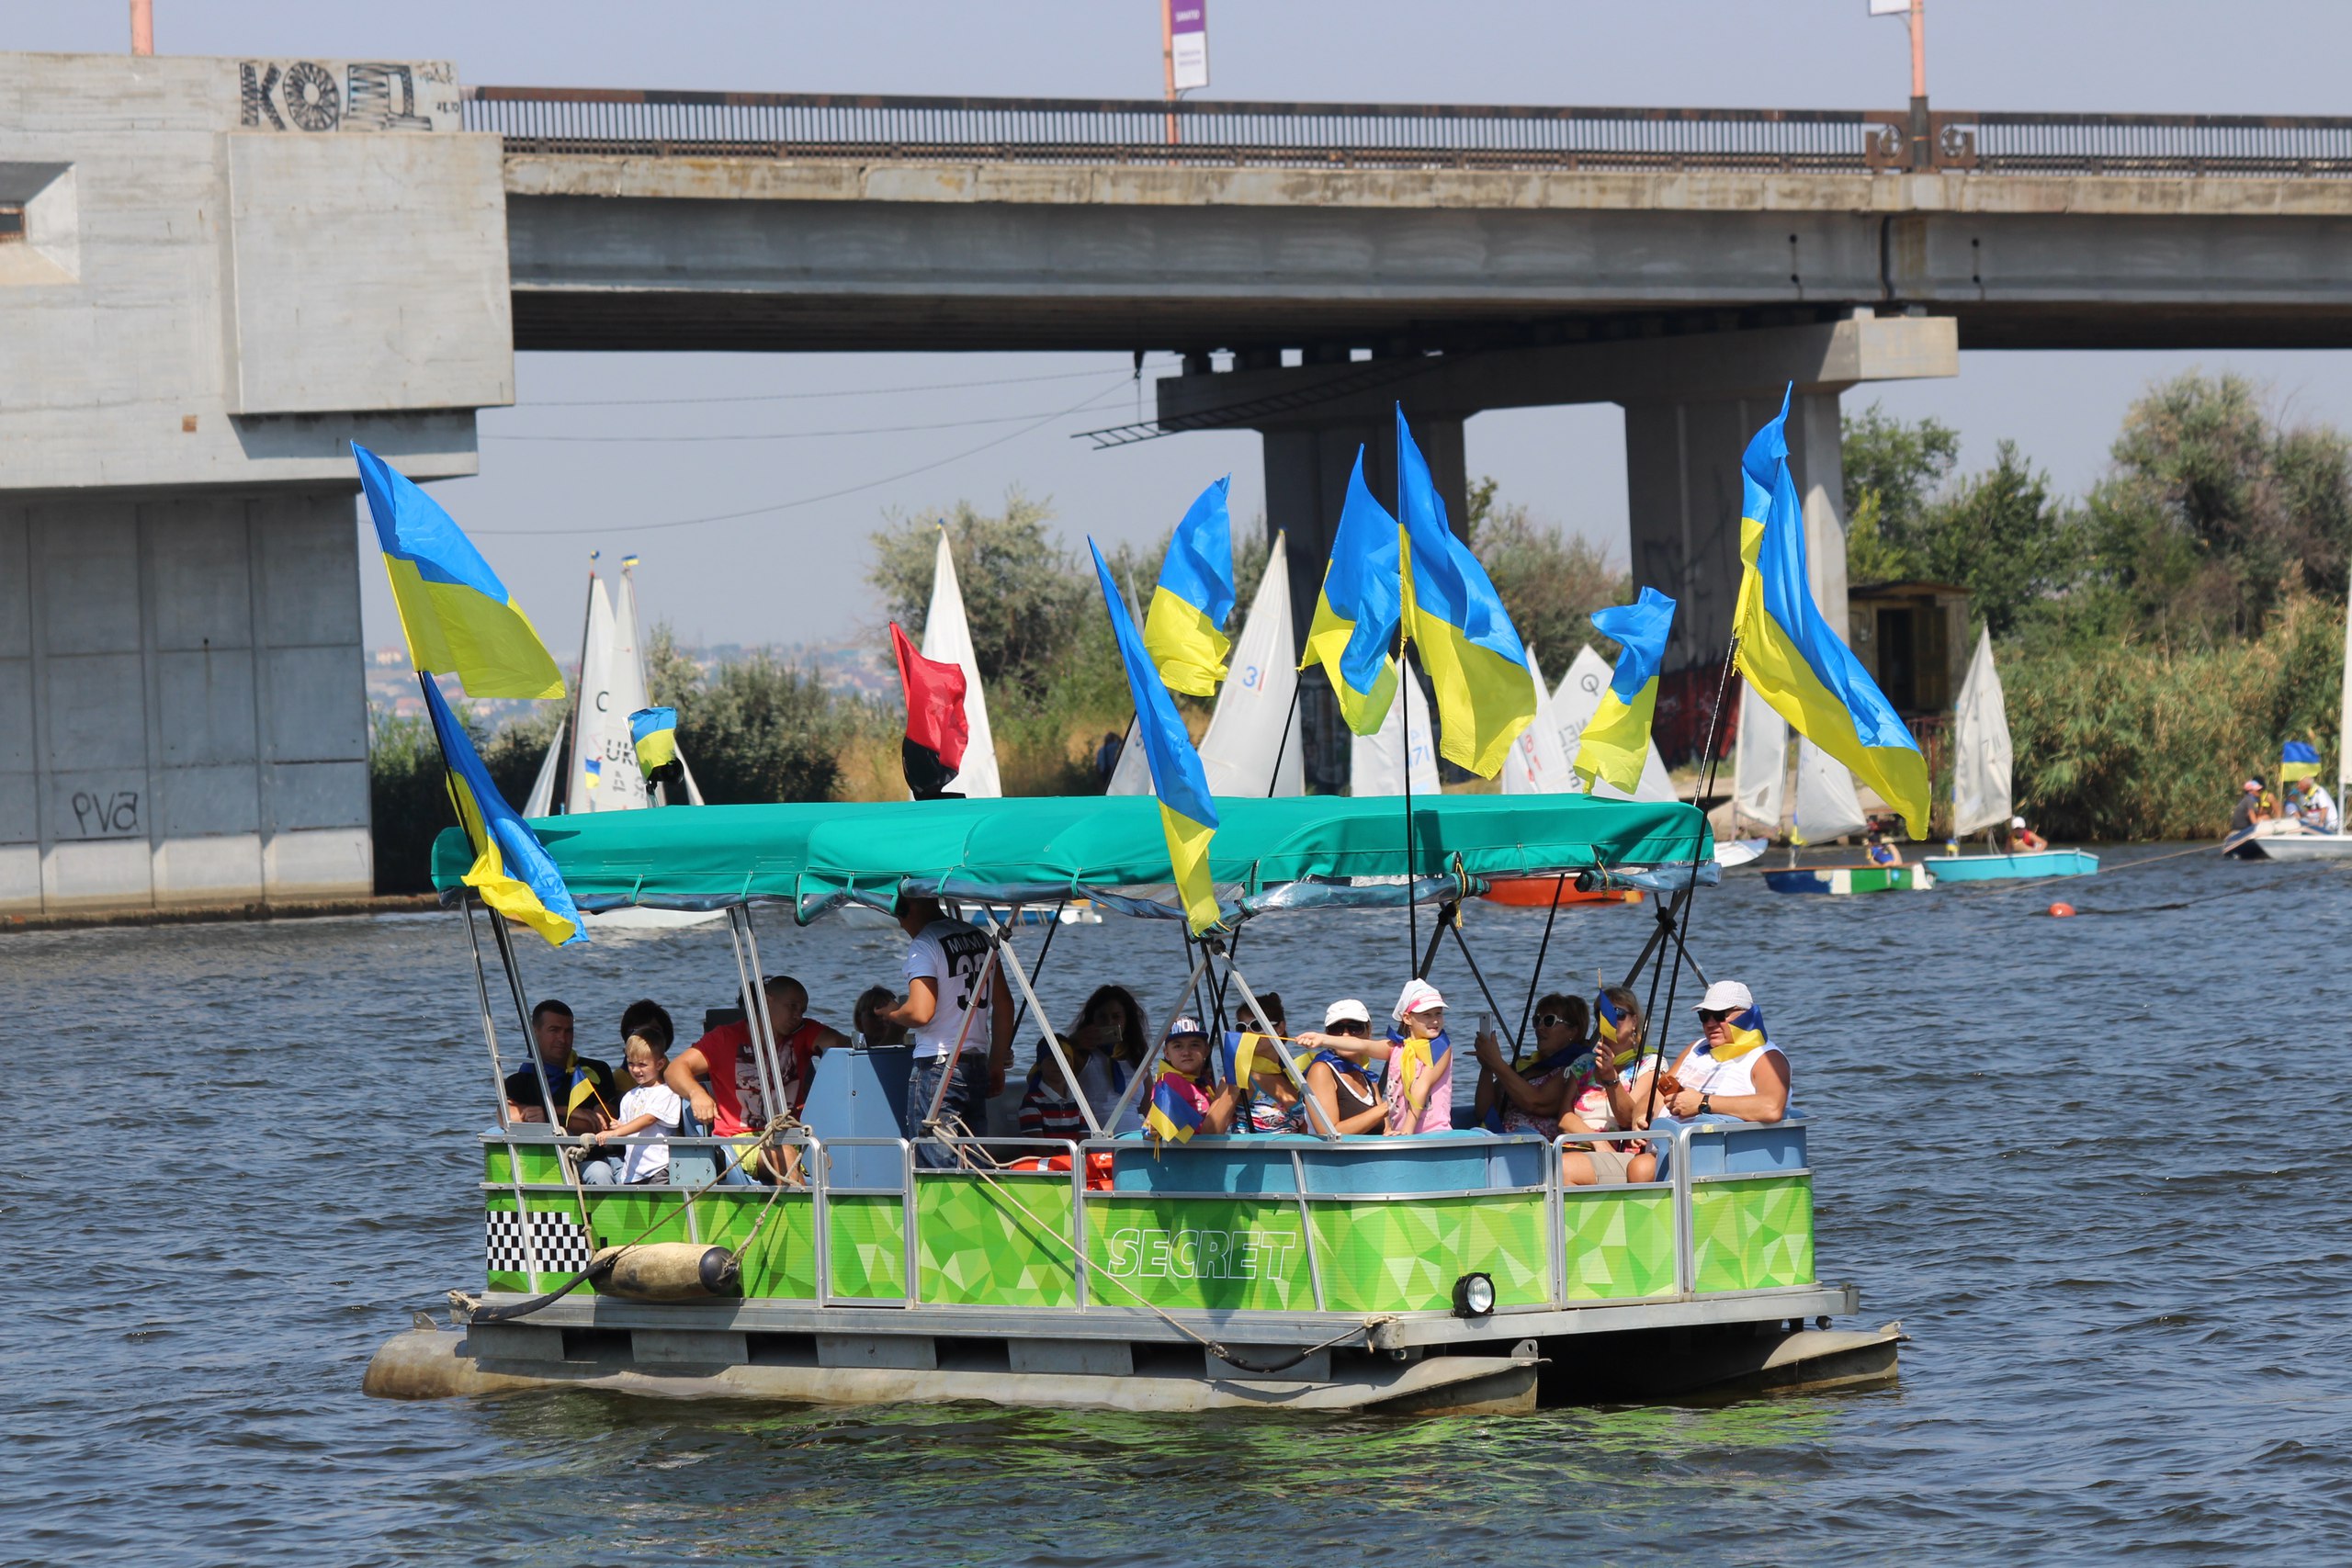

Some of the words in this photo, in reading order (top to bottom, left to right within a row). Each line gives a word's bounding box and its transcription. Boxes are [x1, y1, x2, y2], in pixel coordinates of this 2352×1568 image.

[239, 61, 433, 132] КОД
[946, 933, 986, 954] MIAMI
[1106, 1227, 1296, 1280] SECRET
